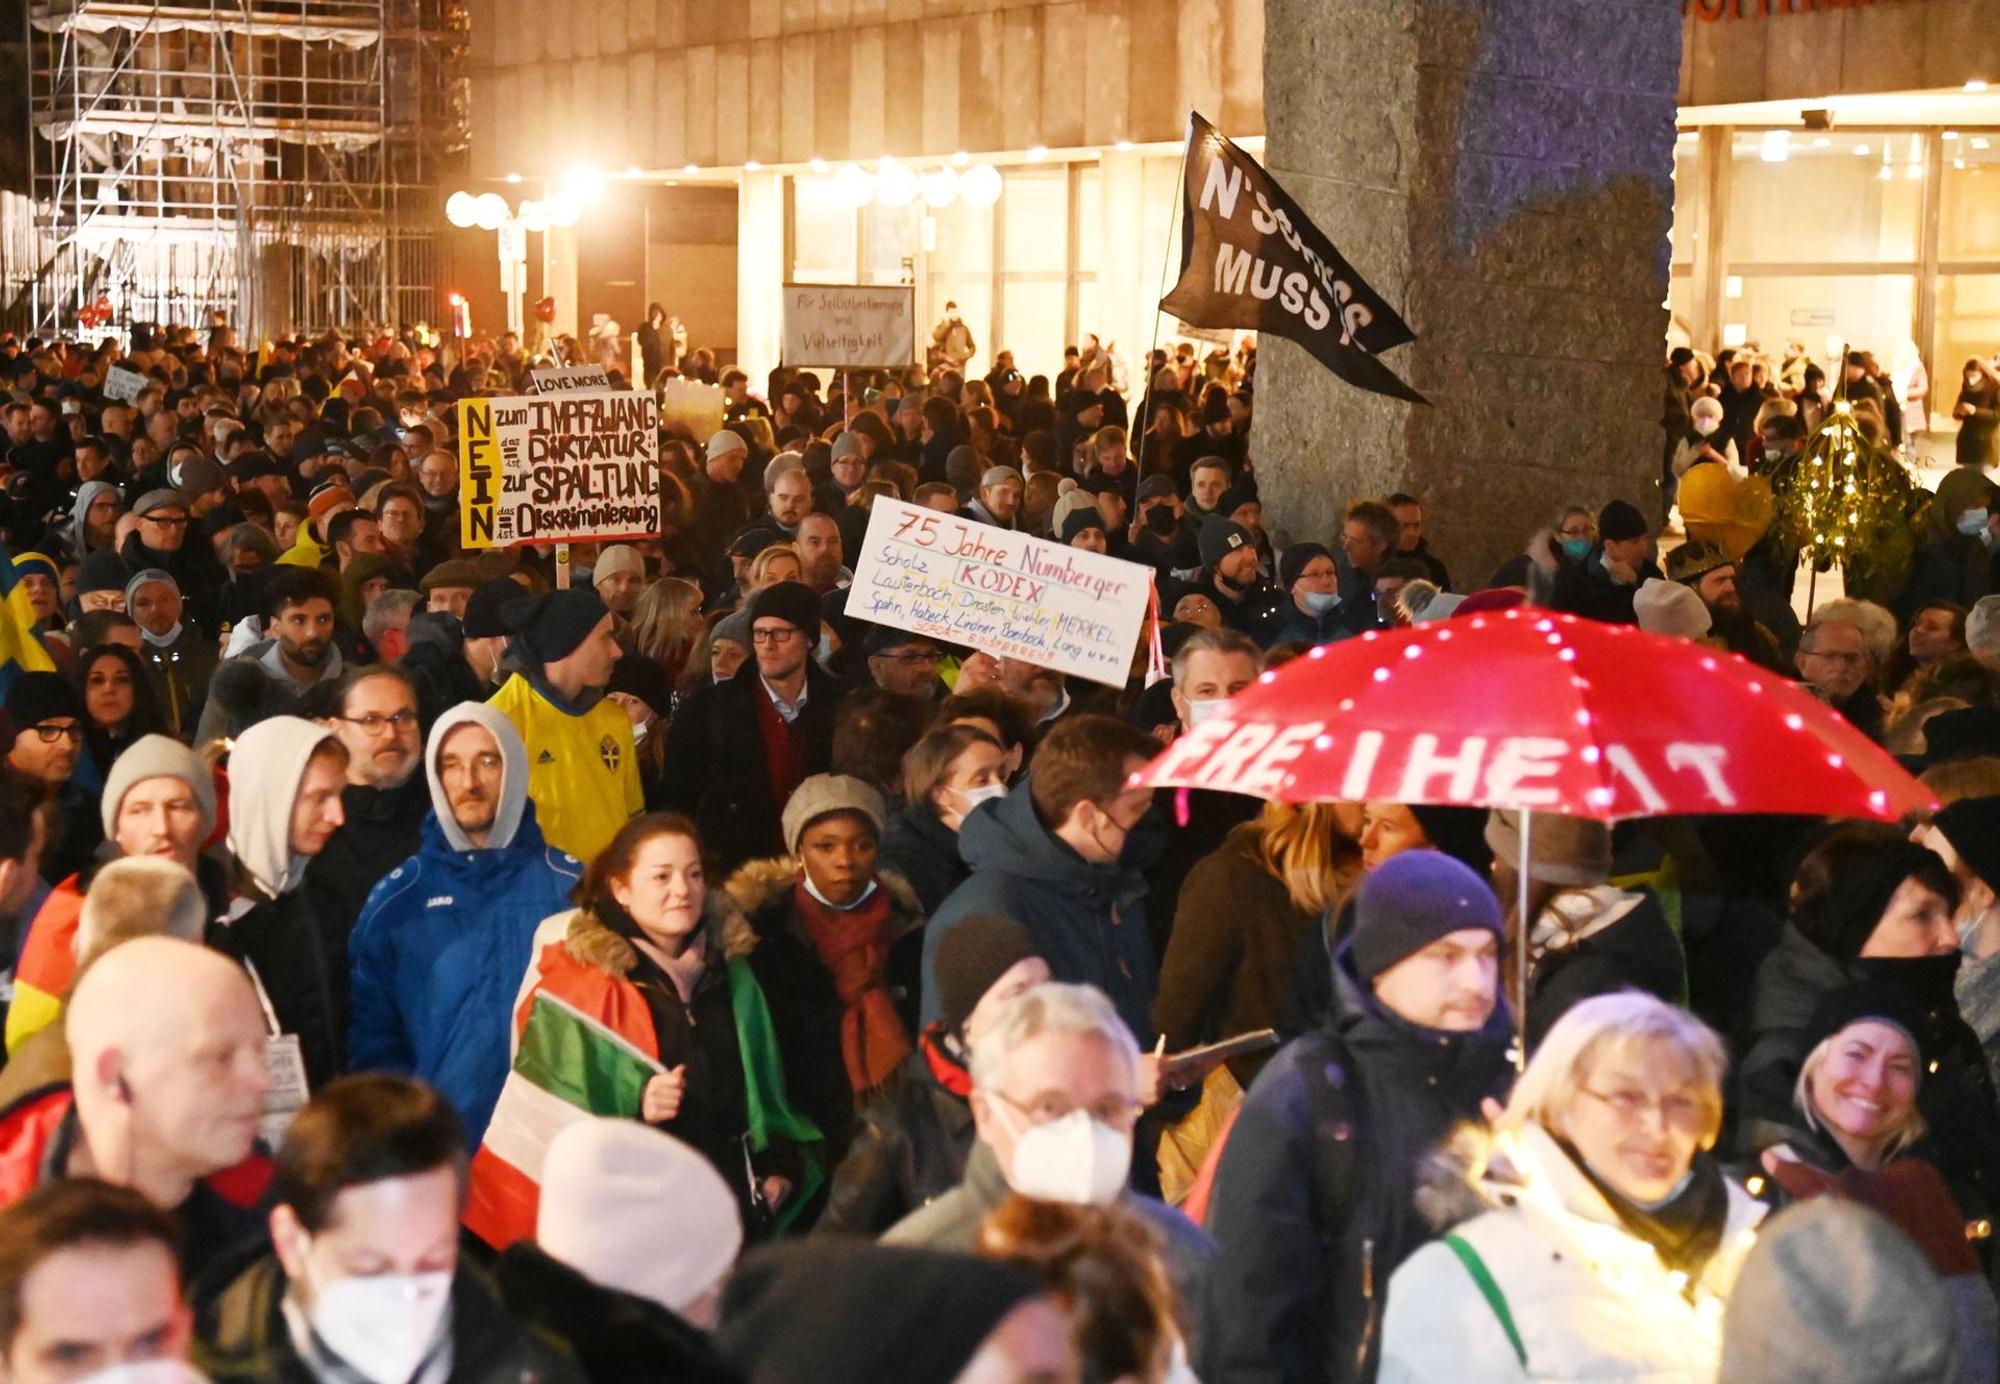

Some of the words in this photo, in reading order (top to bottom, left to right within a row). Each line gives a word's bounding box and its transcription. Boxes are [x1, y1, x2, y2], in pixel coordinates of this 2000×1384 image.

[536, 376, 571, 393] LOVE
[572, 374, 608, 388] MORE
[494, 408, 528, 427] zum
[501, 438, 520, 447] das
[466, 404, 494, 542] NEIN
[502, 472, 533, 493] zur
[532, 461, 660, 506] SPALTUNG
[497, 506, 515, 516] das
[894, 510, 941, 547] 75
[943, 524, 1008, 567] Jahre
[960, 564, 1044, 603] KODEX
[426, 895, 454, 908] JAKO
